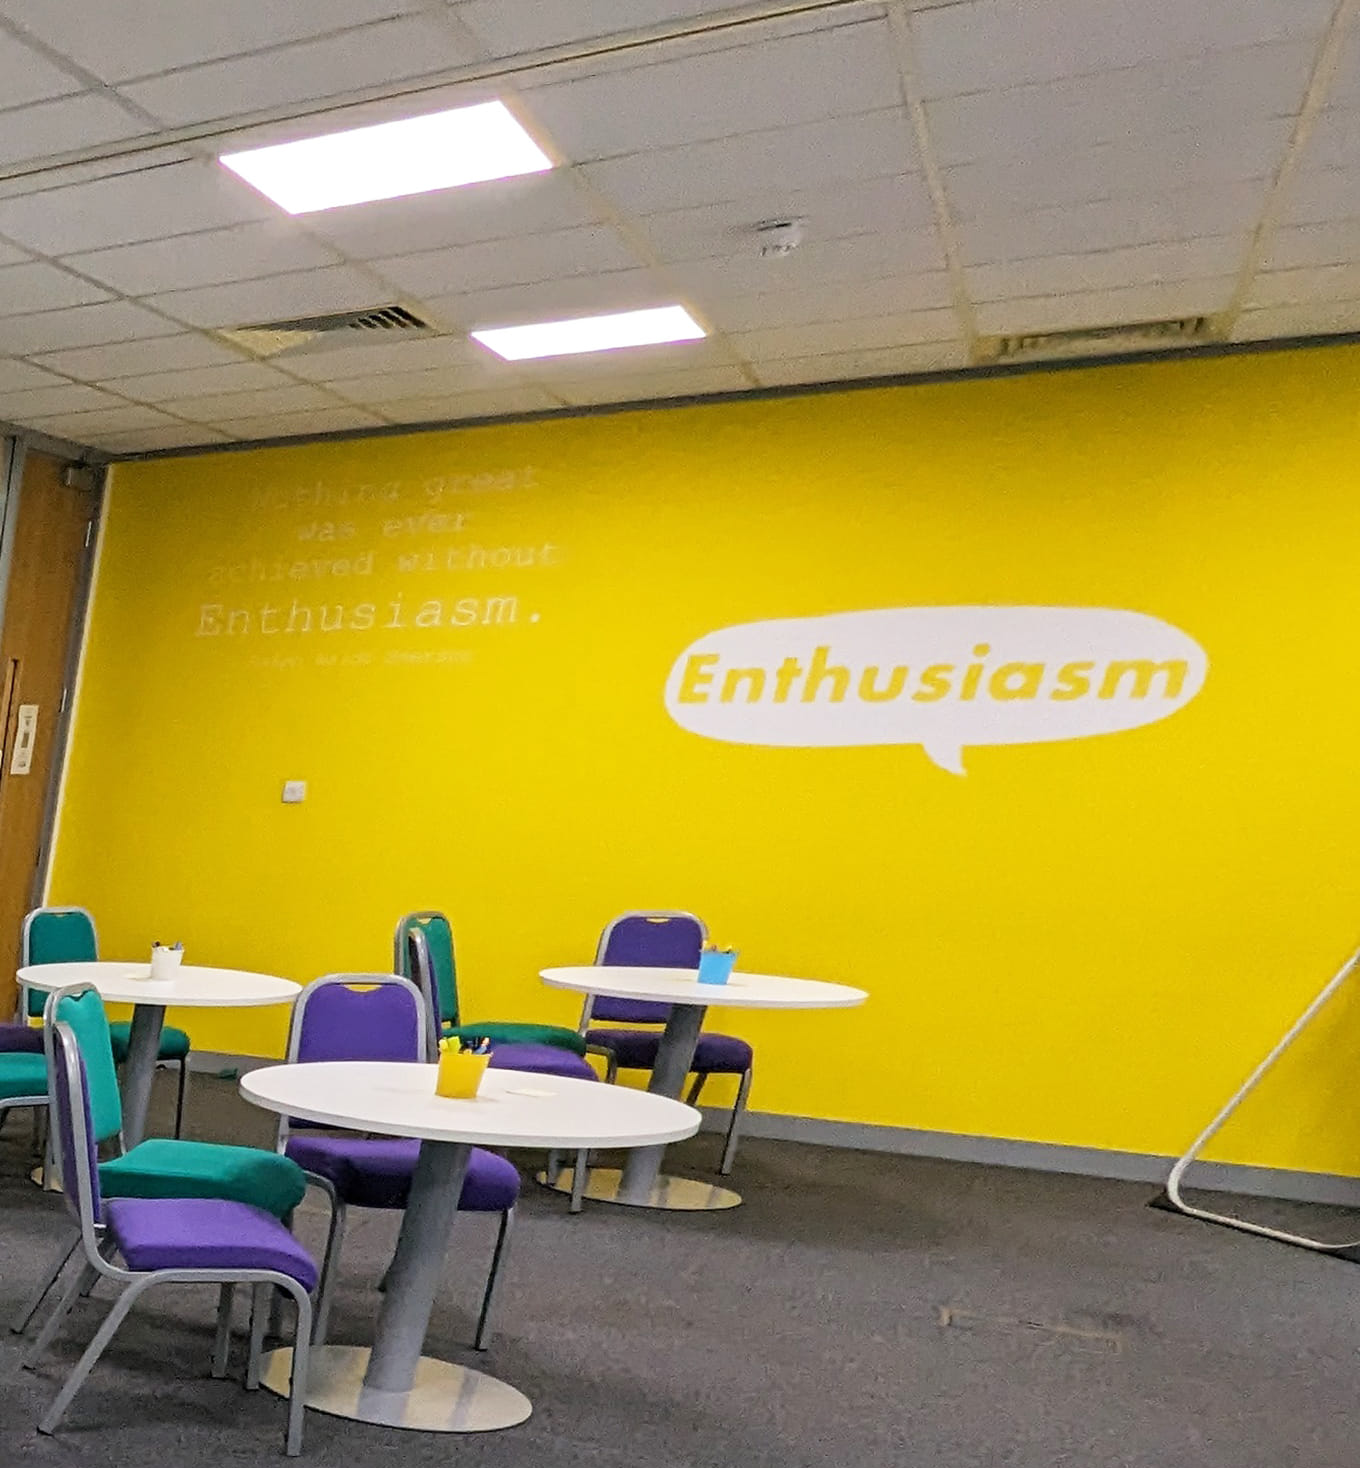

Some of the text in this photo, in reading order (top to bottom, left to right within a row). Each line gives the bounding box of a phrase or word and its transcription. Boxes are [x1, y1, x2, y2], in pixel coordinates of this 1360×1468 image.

[425, 466, 538, 504] great
[297, 509, 474, 542] was ever
[208, 540, 561, 583] achieved without
[194, 591, 543, 638] Enthusiasm.
[677, 643, 1188, 704] Enthusiasm
